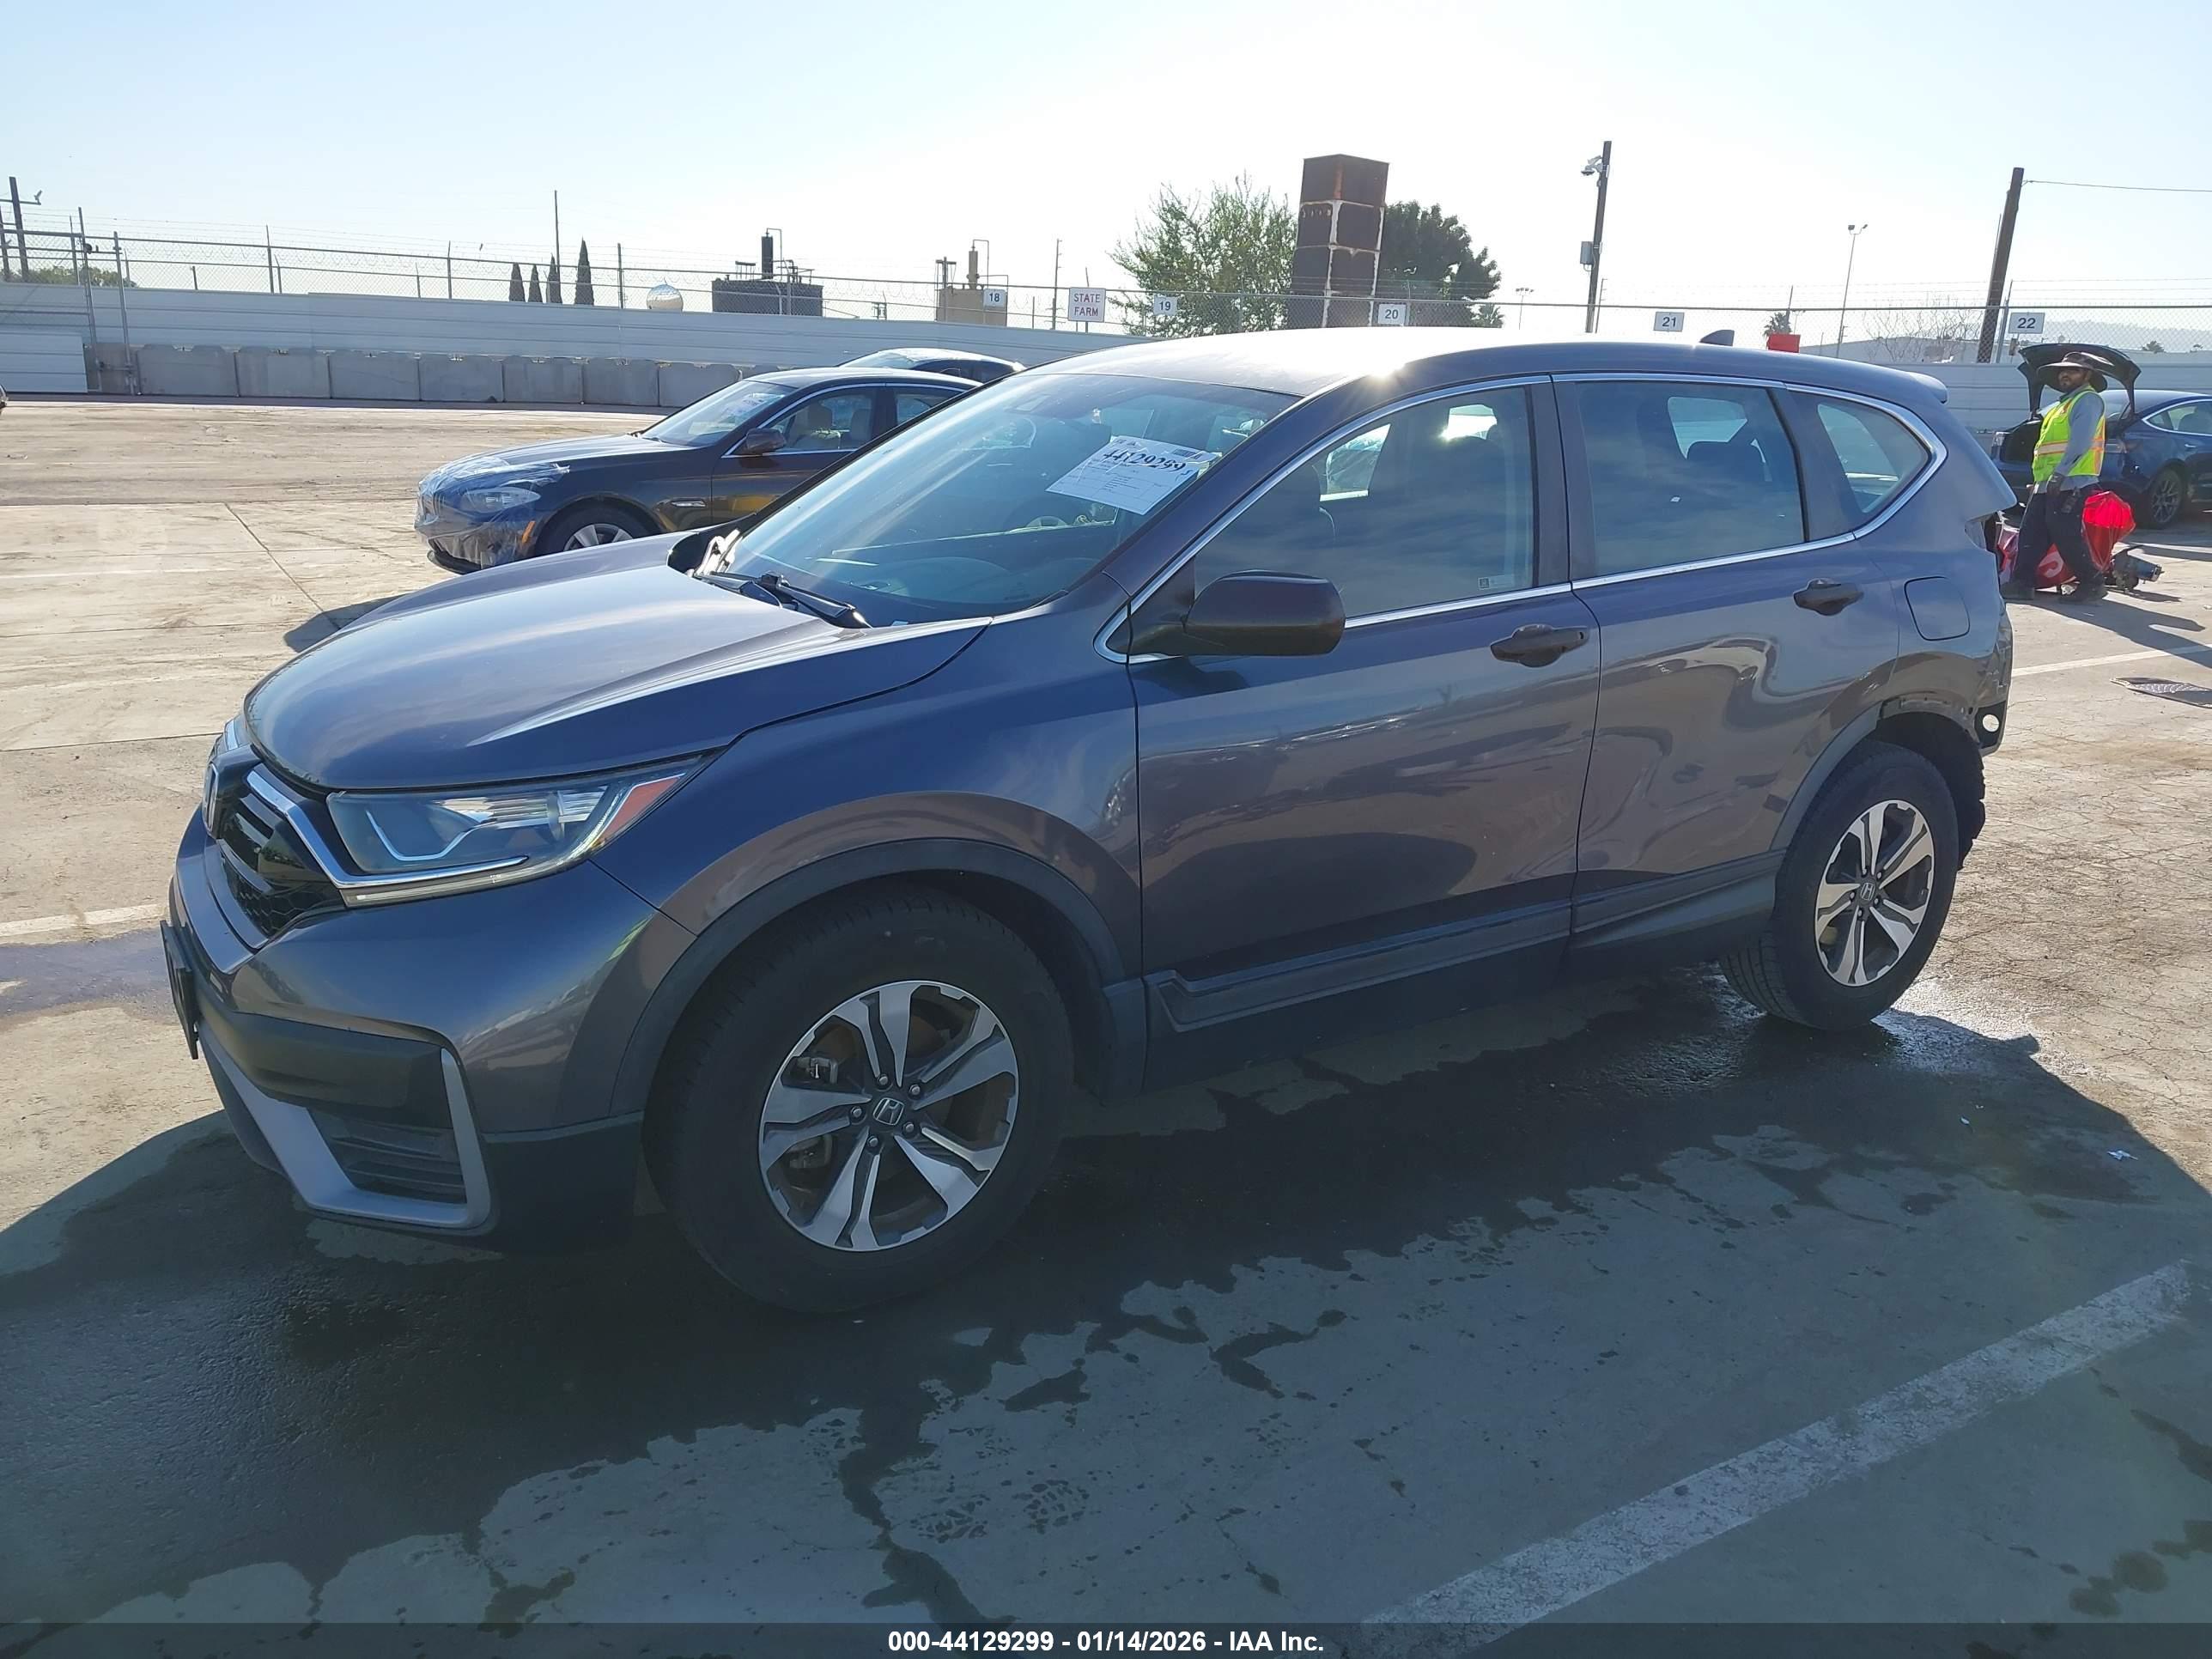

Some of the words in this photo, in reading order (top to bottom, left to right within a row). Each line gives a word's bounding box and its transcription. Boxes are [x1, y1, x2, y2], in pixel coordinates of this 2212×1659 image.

[988, 292, 1000, 302] 18
[1073, 293, 1101, 303] STATE
[1159, 301, 1171, 311] 19
[1073, 307, 1098, 317] FARM
[1384, 308, 1399, 319] 20
[1662, 316, 1676, 328] 21
[2017, 317, 2036, 329] 22
[1102, 449, 1187, 472] 44129299
